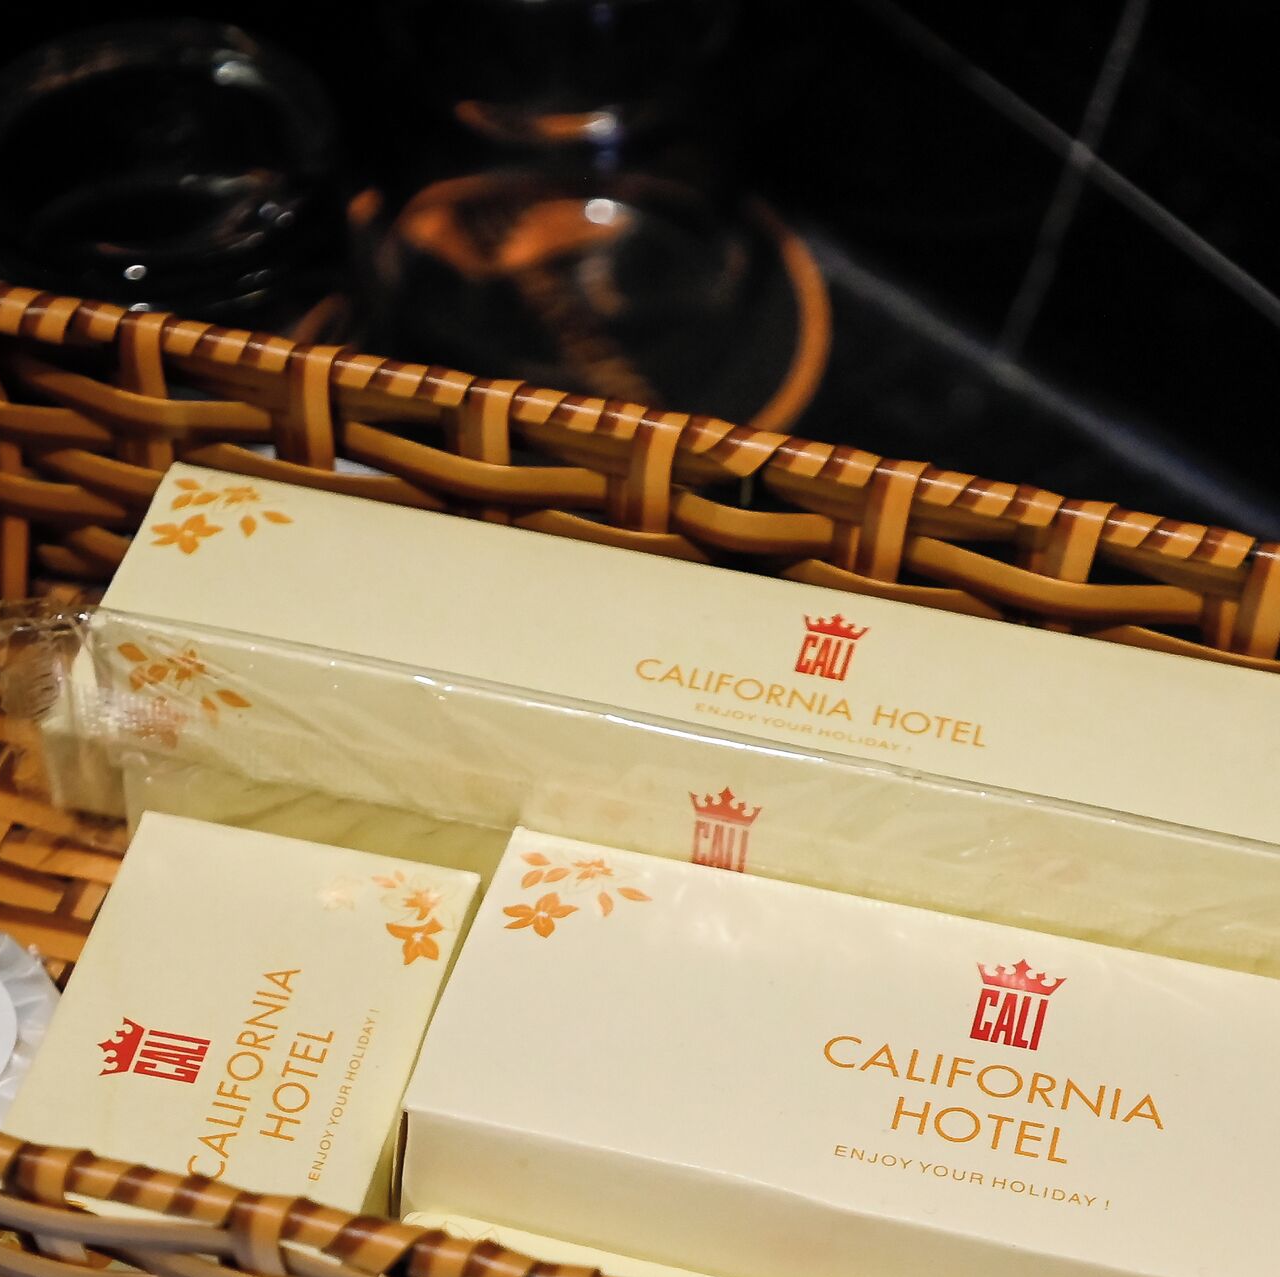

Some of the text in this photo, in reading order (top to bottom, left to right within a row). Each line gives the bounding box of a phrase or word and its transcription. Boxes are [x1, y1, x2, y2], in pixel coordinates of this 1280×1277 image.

[794, 633, 856, 682] CALI
[634, 658, 987, 748] CALIFORNIA HOTEL
[694, 702, 757, 722] ENJOY
[762, 716, 814, 734] YOUR
[817, 727, 900, 751] HOLIDAY
[690, 819, 750, 873] CALI
[969, 987, 1050, 1051] CALI
[133, 1029, 212, 1084] CALI
[186, 968, 302, 1180] CALIFORNIA
[259, 1031, 335, 1142] HOTEL
[823, 1035, 1165, 1131] CALIFORNIA
[308, 1129, 335, 1182] ENJOY
[327, 1084, 353, 1127] YOUR
[344, 1016, 377, 1082] HOLIDAY
[889, 1096, 1069, 1165] HOTEL
[833, 1144, 913, 1170] ENJOY
[919, 1160, 985, 1186] YOUR
[990, 1176, 1097, 1208] HOLIDAY
